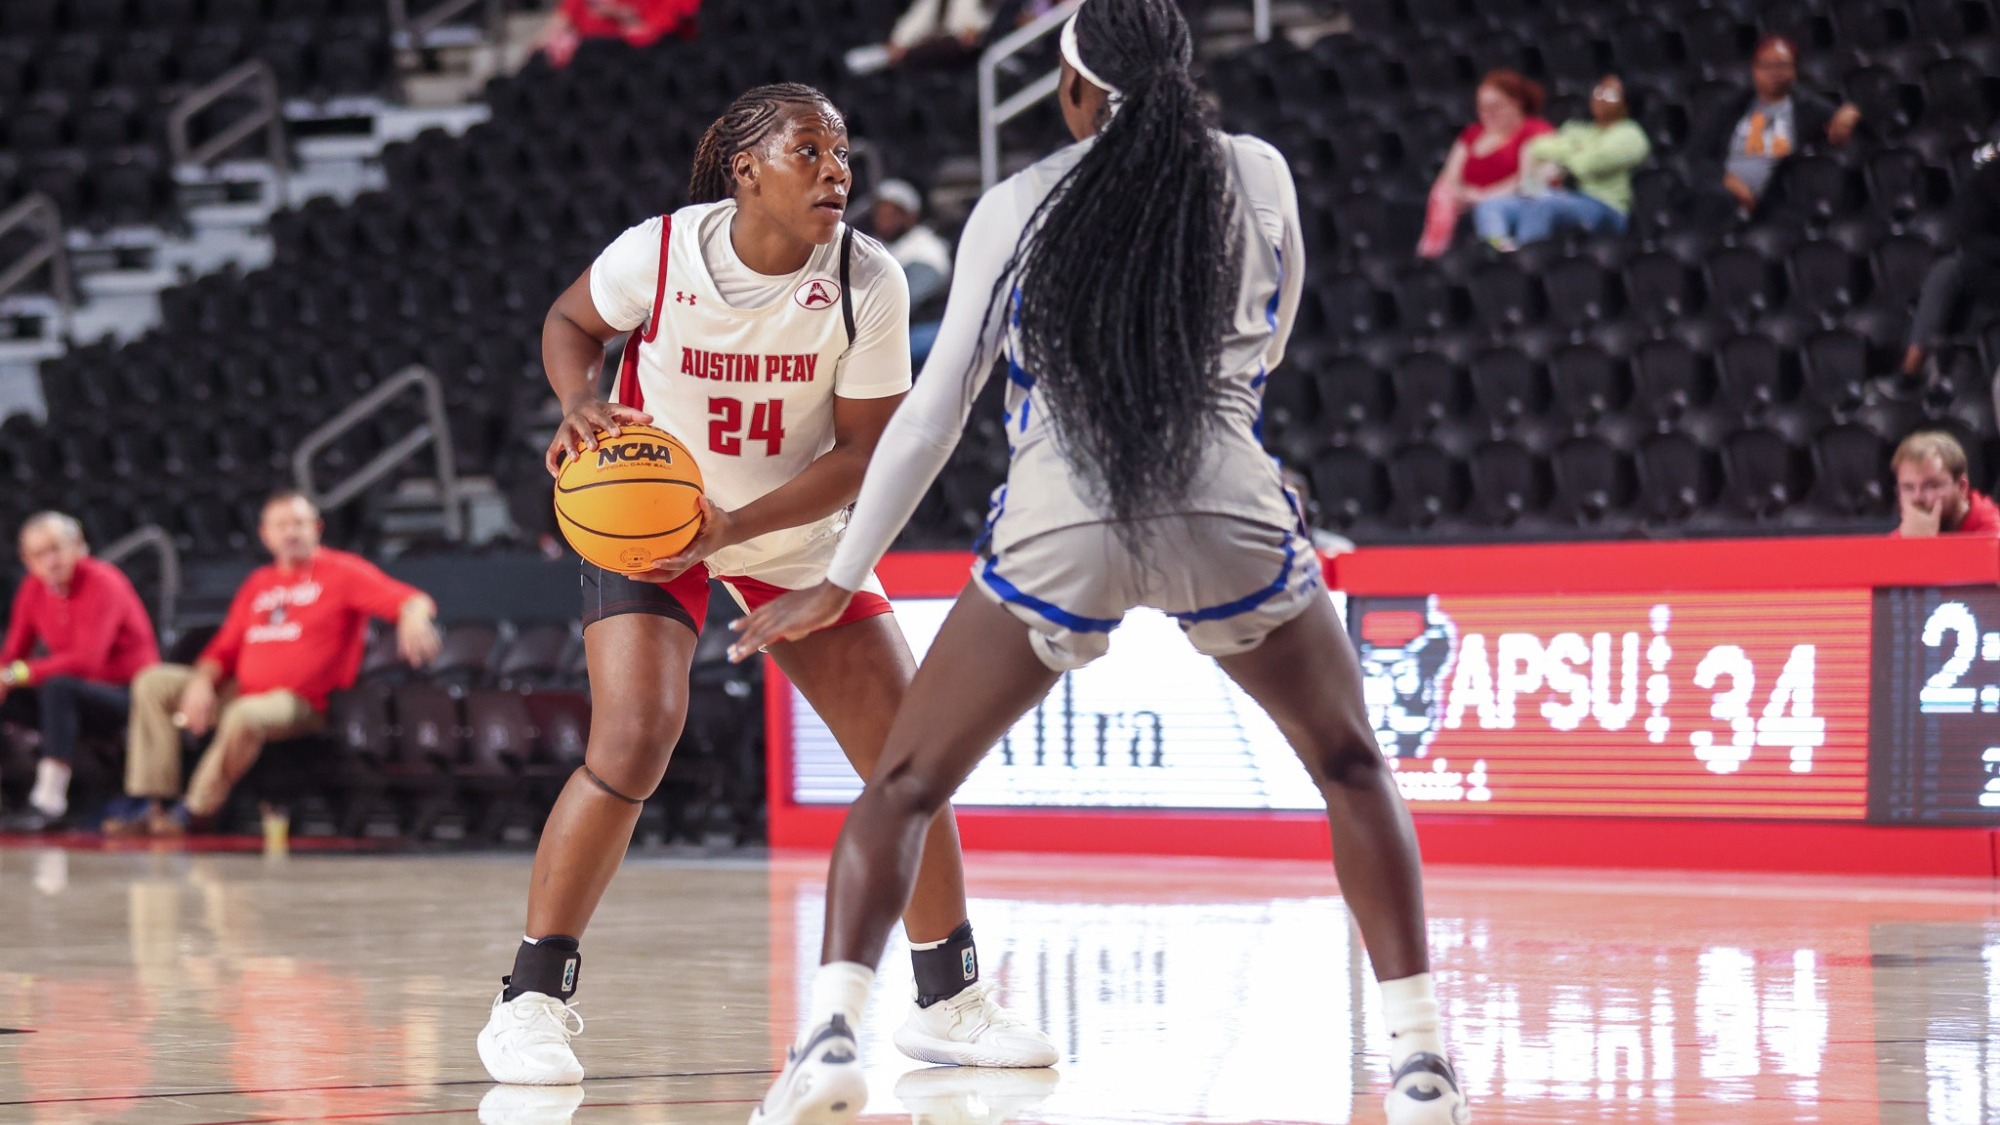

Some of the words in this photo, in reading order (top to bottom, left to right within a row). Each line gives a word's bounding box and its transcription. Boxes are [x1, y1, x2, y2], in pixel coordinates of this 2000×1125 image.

[681, 346, 760, 382] AUSTIN
[765, 353, 819, 382] PEAY
[597, 443, 672, 467] NCAA
[708, 396, 785, 457] 24
[1444, 633, 1640, 732] APSU
[1690, 645, 1825, 773] 34
